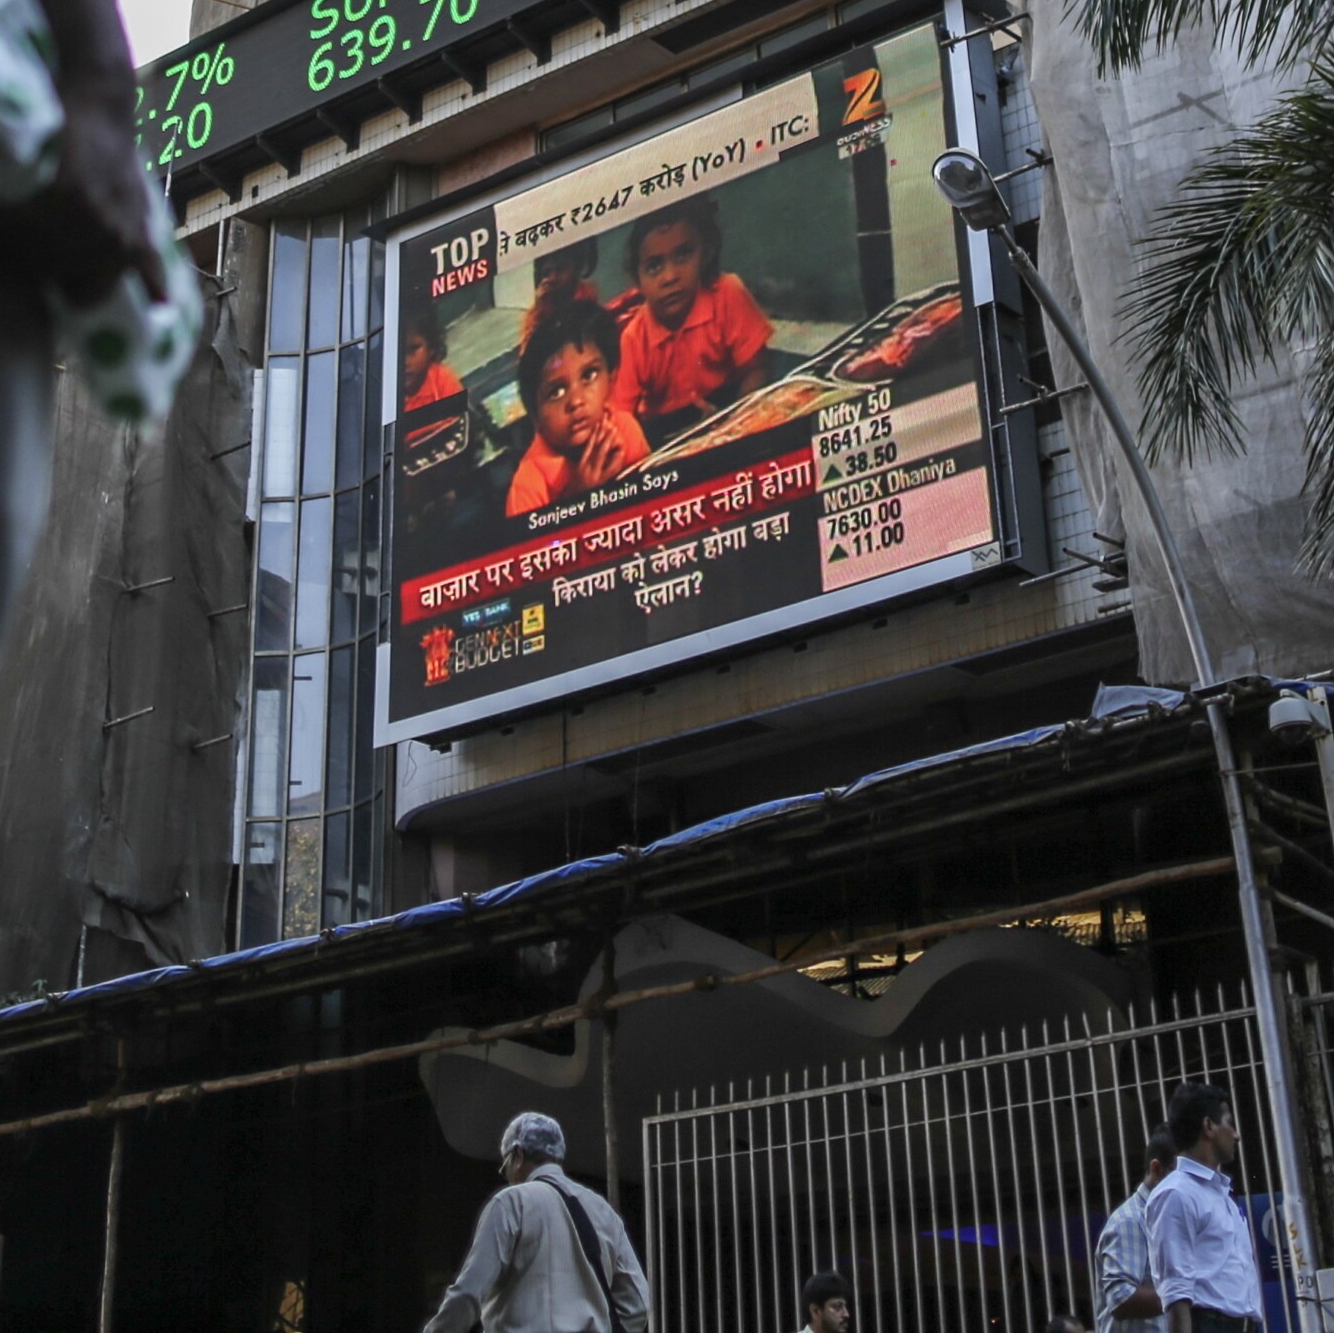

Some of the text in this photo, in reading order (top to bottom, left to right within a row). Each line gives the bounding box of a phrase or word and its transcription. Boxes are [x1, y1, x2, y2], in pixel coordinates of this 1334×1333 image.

[570, 185, 634, 226] ₹2647
[639, 163, 687, 197] करोड़
[691, 137, 747, 182] (YoY)
[770, 114, 810, 145] ITC:
[430, 227, 490, 276] TOP
[431, 259, 488, 298] NEWS
[818, 388, 891, 432] Nifty 50
[819, 415, 893, 458] 8641.25
[845, 441, 898, 477] 38.50
[528, 470, 679, 530] Sanjeev Bhasin Says
[823, 457, 957, 514] NCDEX Dhaniya
[484, 558, 515, 586] पर
[519, 537, 578, 580] इसका
[582, 515, 644, 552] ज्यादा
[650, 495, 706, 534] असर
[711, 471, 754, 513] नहीं
[759, 459, 812, 500] होगा
[827, 497, 902, 540] 7630.00
[853, 522, 905, 557] 11.00
[551, 567, 617, 607] किराया
[620, 552, 647, 584] को
[650, 541, 698, 573] लेकर
[702, 525, 747, 560] होगा
[634, 570, 704, 614] ऐलान?
